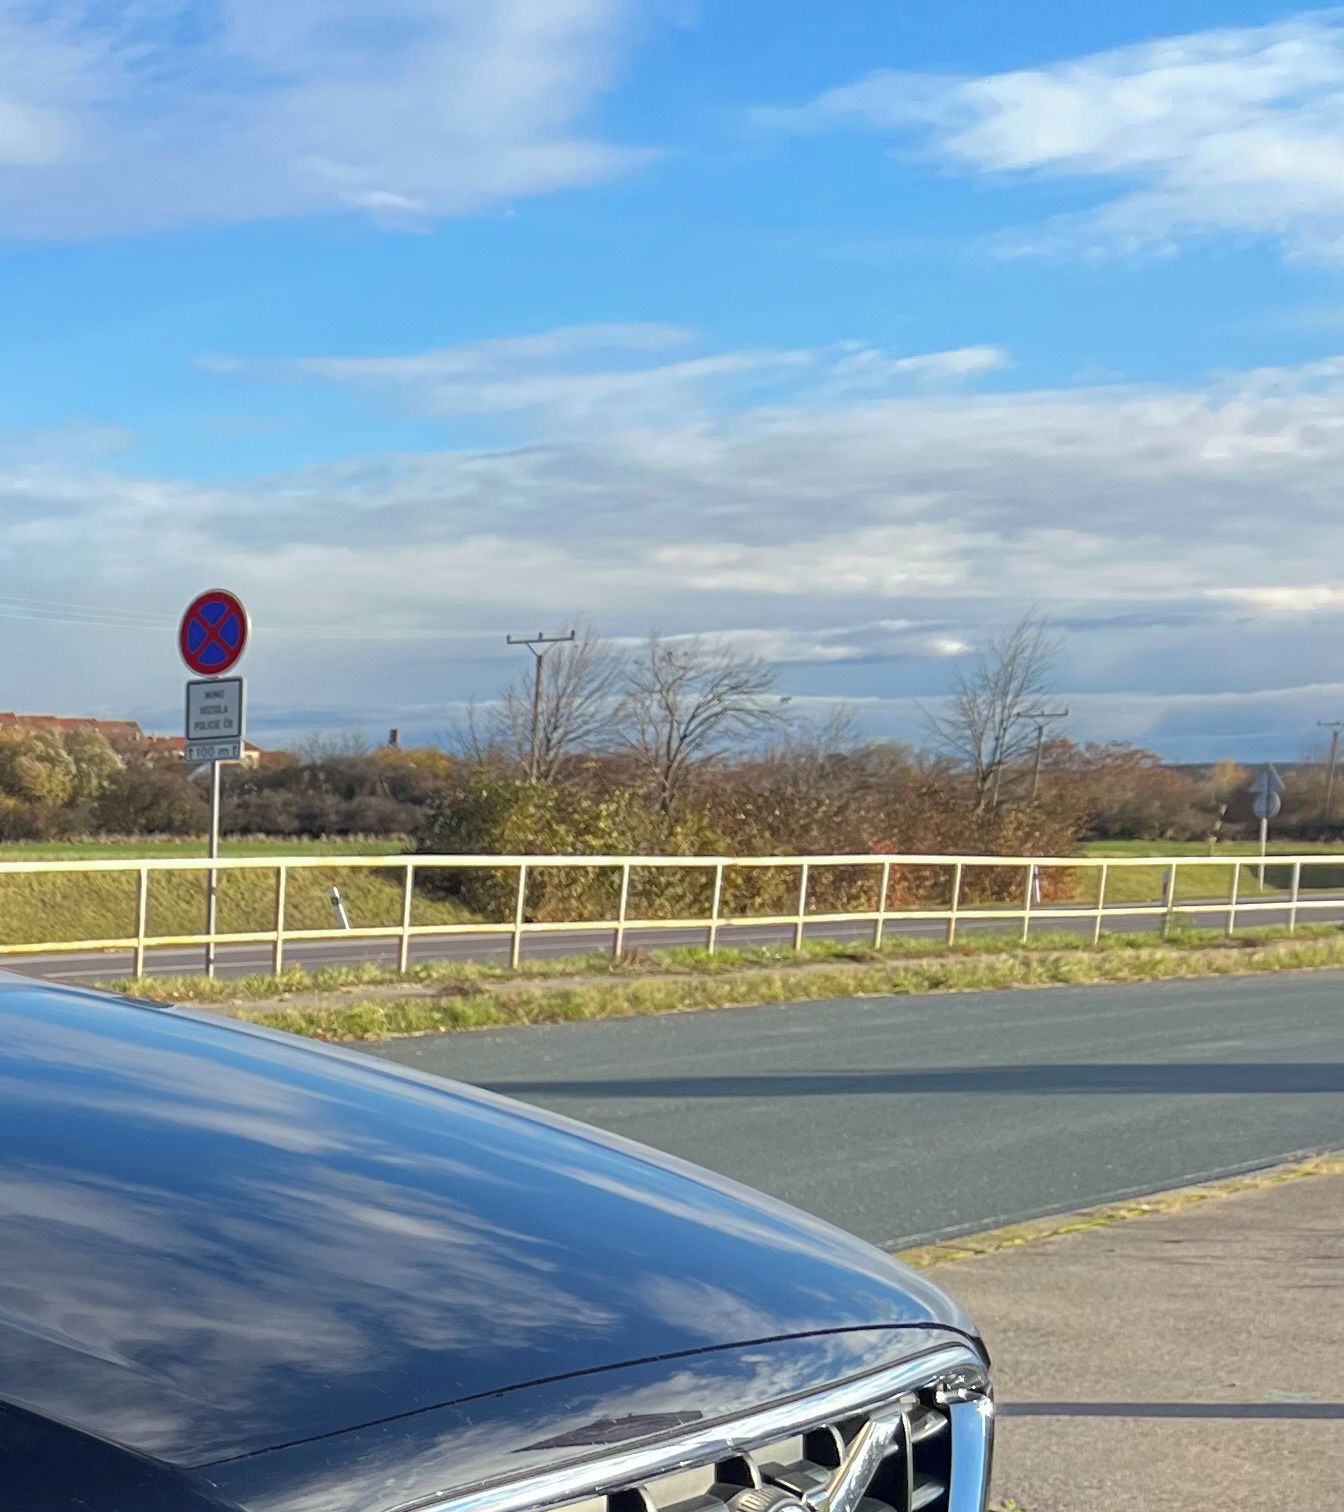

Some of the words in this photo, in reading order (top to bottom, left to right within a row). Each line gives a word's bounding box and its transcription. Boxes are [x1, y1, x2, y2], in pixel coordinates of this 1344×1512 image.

[194, 720, 221, 731] POLICIE
[197, 746, 215, 758] 100
[218, 748, 229, 757] m
